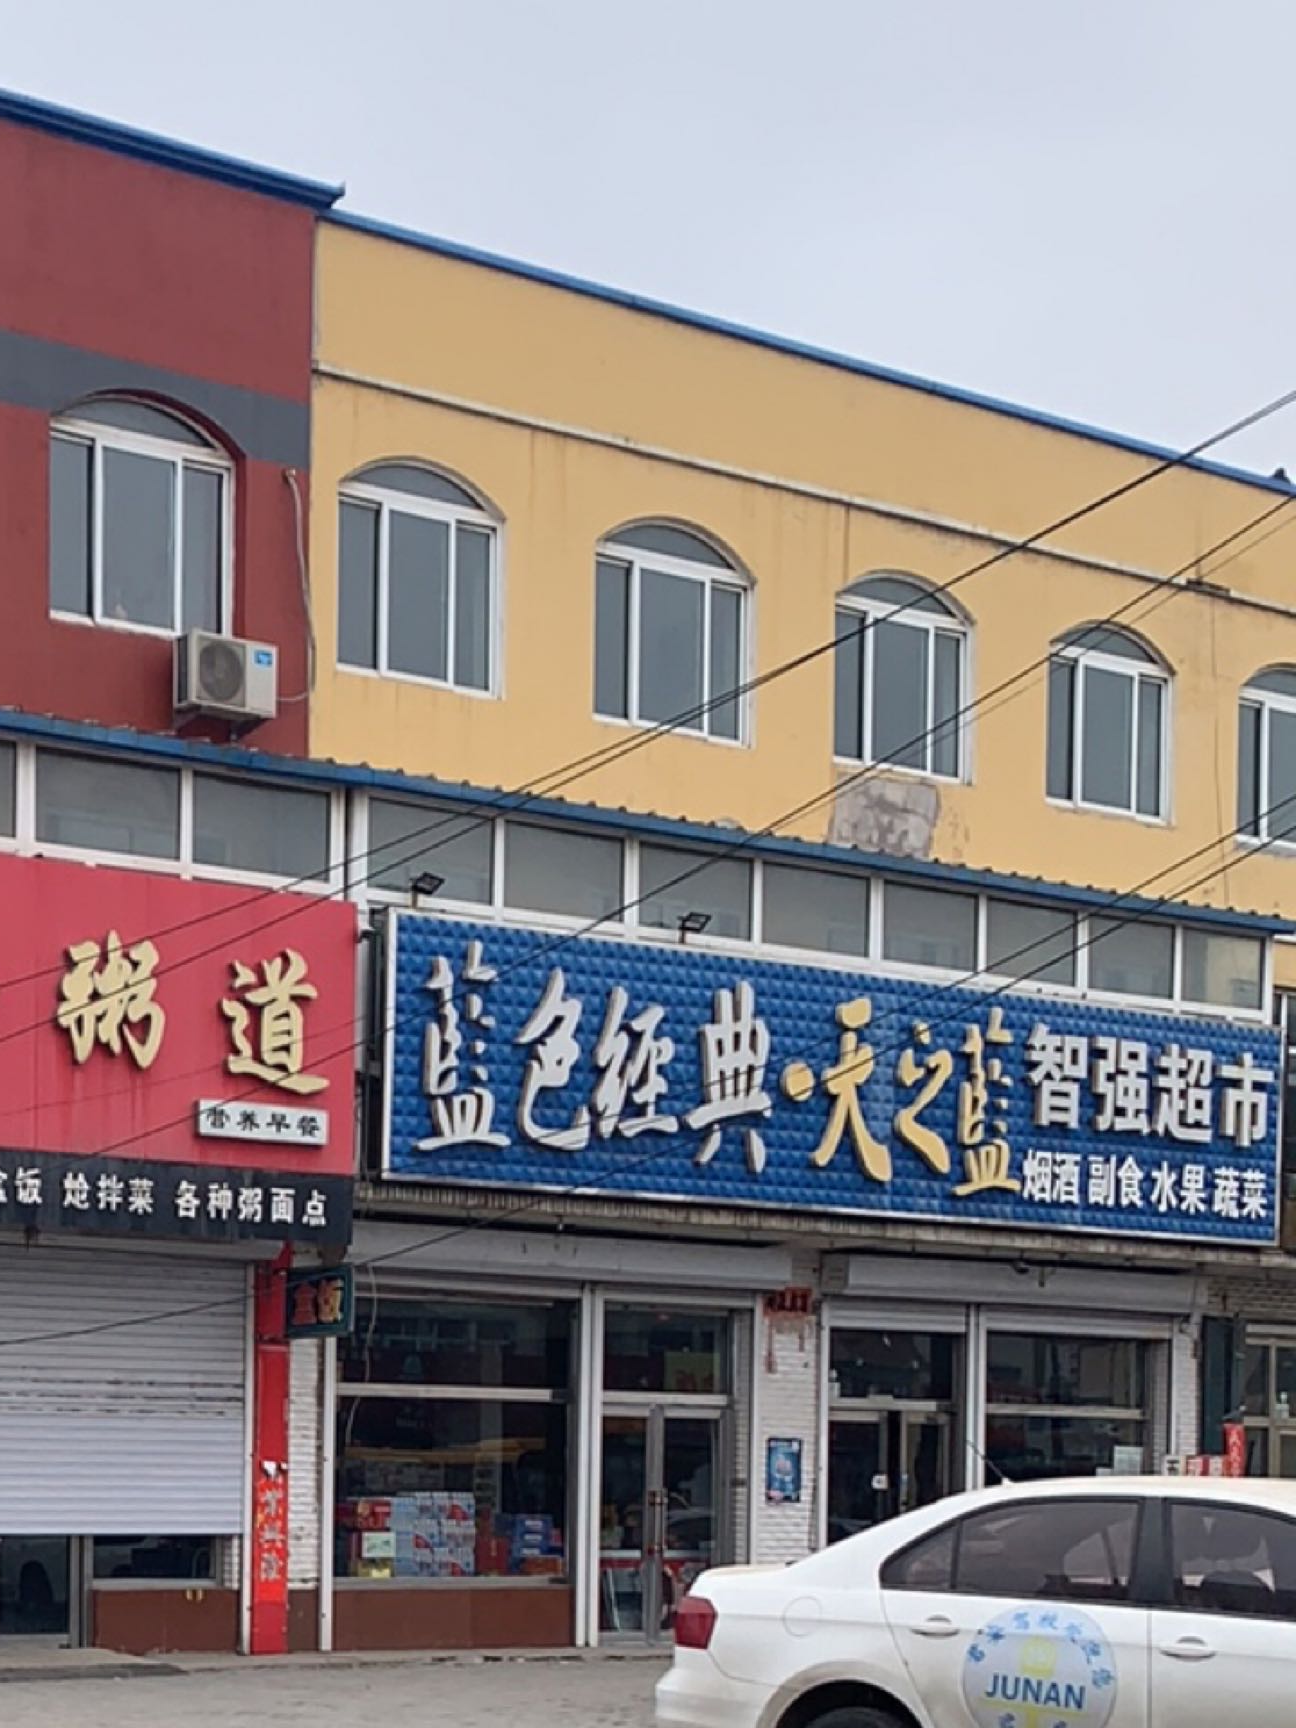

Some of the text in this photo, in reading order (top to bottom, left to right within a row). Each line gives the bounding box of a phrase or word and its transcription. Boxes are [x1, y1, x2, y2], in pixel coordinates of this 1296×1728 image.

[1024, 1022, 1275, 1147] 智强超市
[175, 1180, 327, 1227] 各种粥面点
[1023, 1149, 1267, 1219] 烟酒 副食 水果 蔬菜
[984, 1672, 1086, 1710] JUNAN
